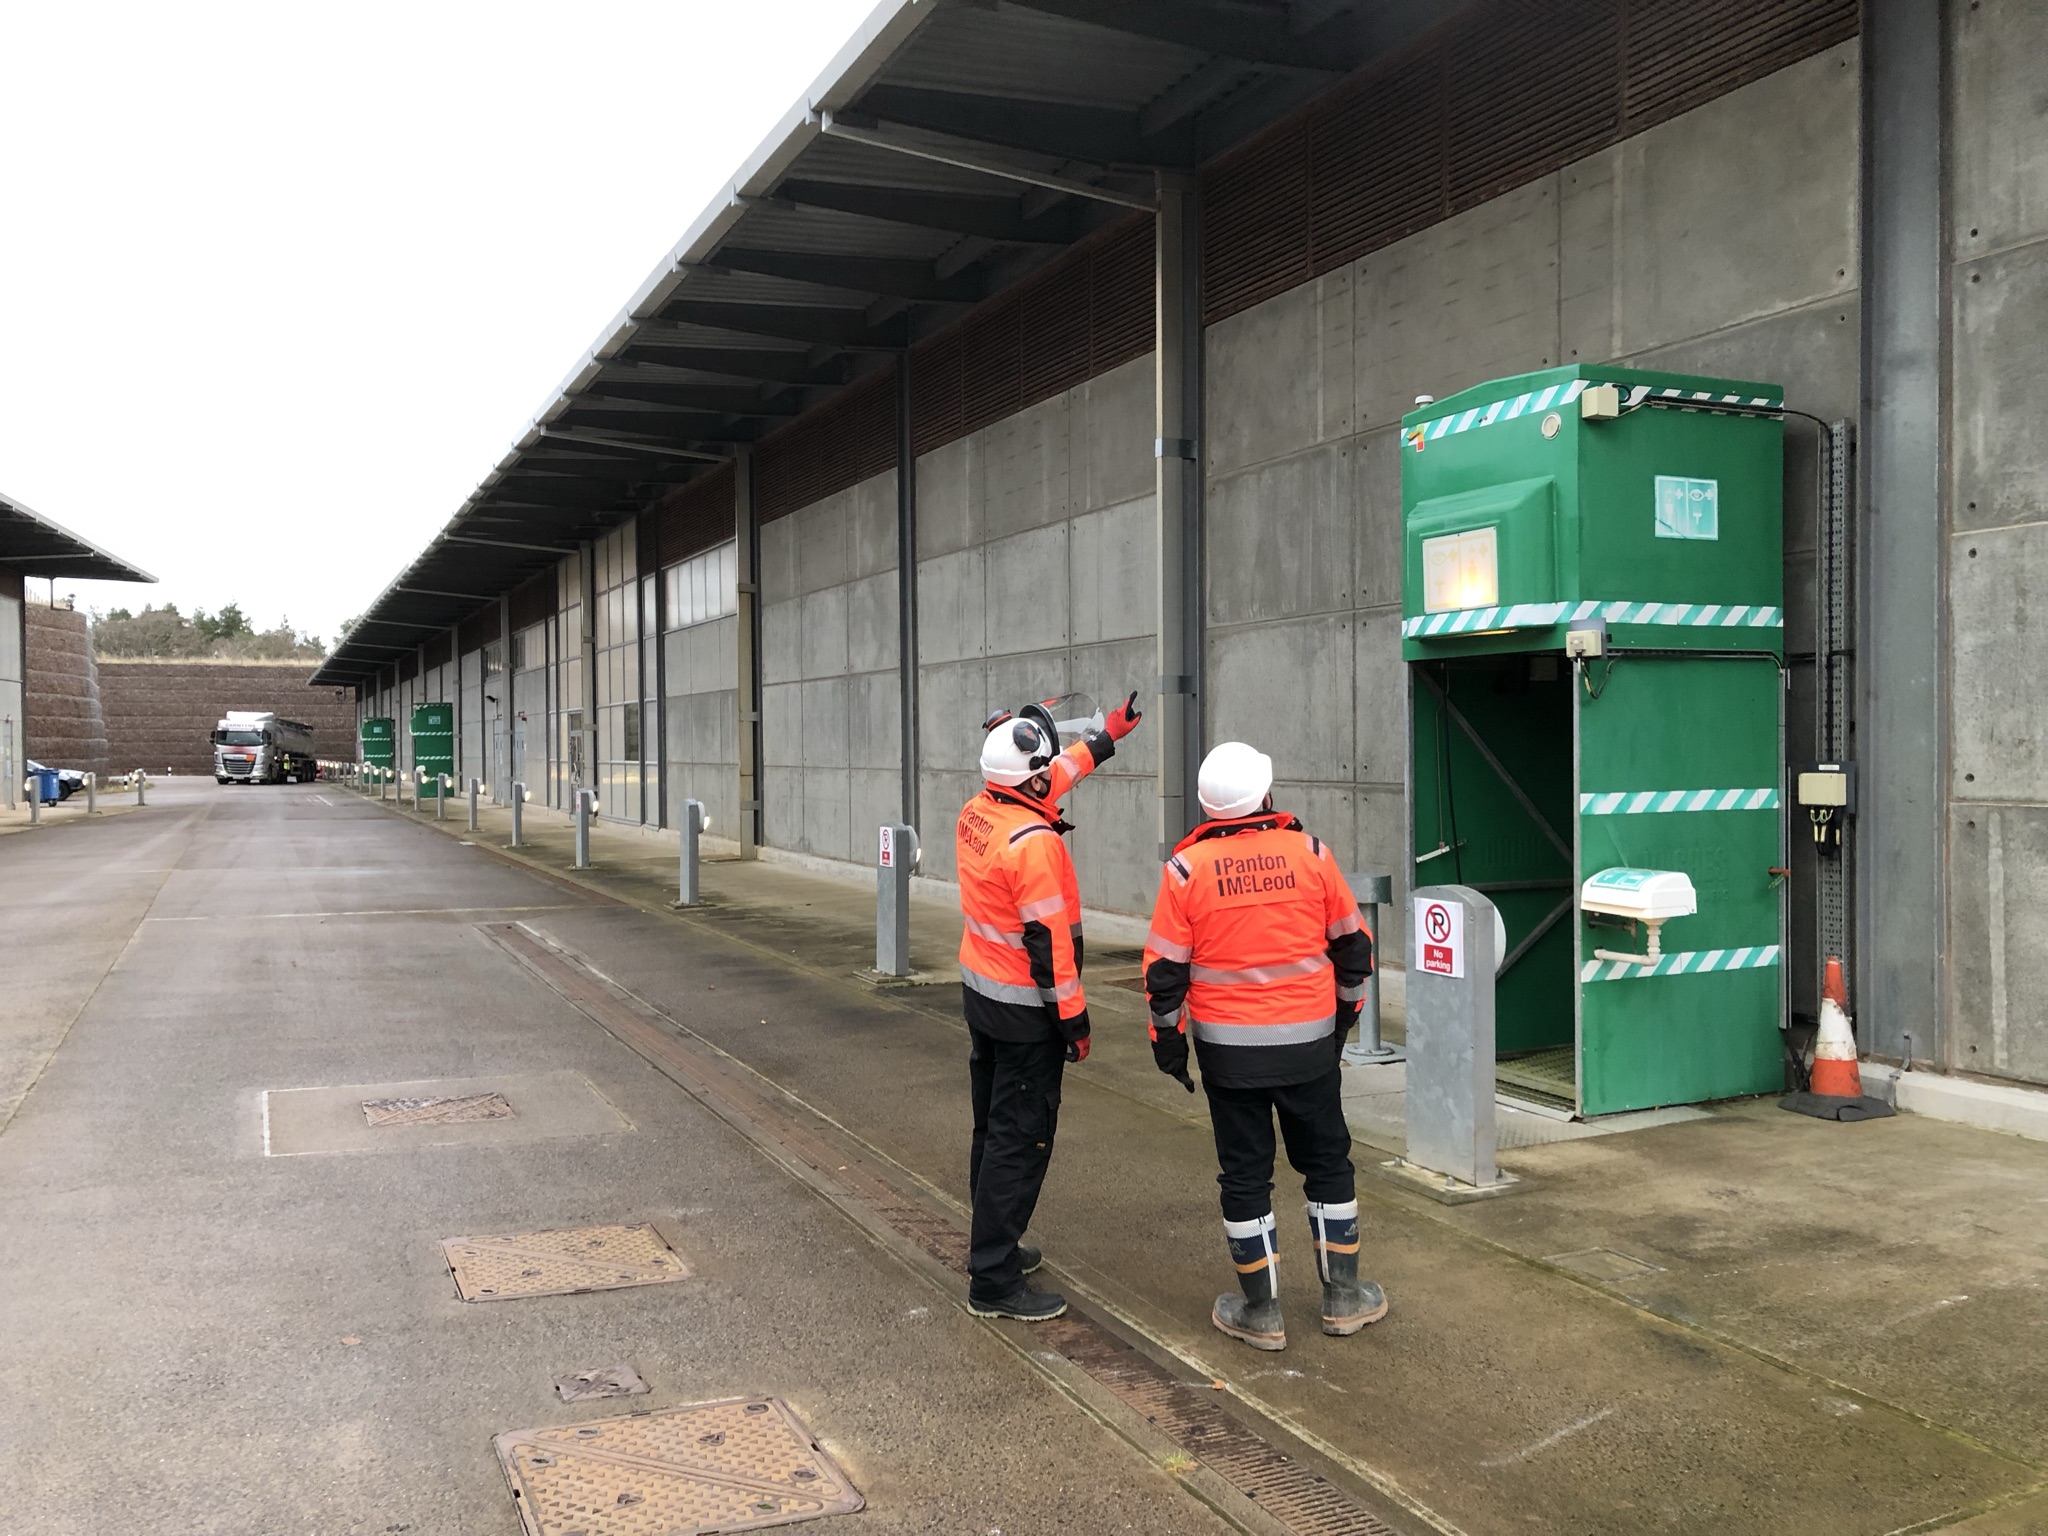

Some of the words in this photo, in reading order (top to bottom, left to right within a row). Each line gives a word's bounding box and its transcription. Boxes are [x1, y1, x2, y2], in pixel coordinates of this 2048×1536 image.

[964, 804, 994, 838] Panton
[1222, 853, 1287, 876] Panton
[1226, 870, 1296, 897] McLeod
[1425, 959, 1451, 972] parking
[1433, 949, 1444, 959] No
